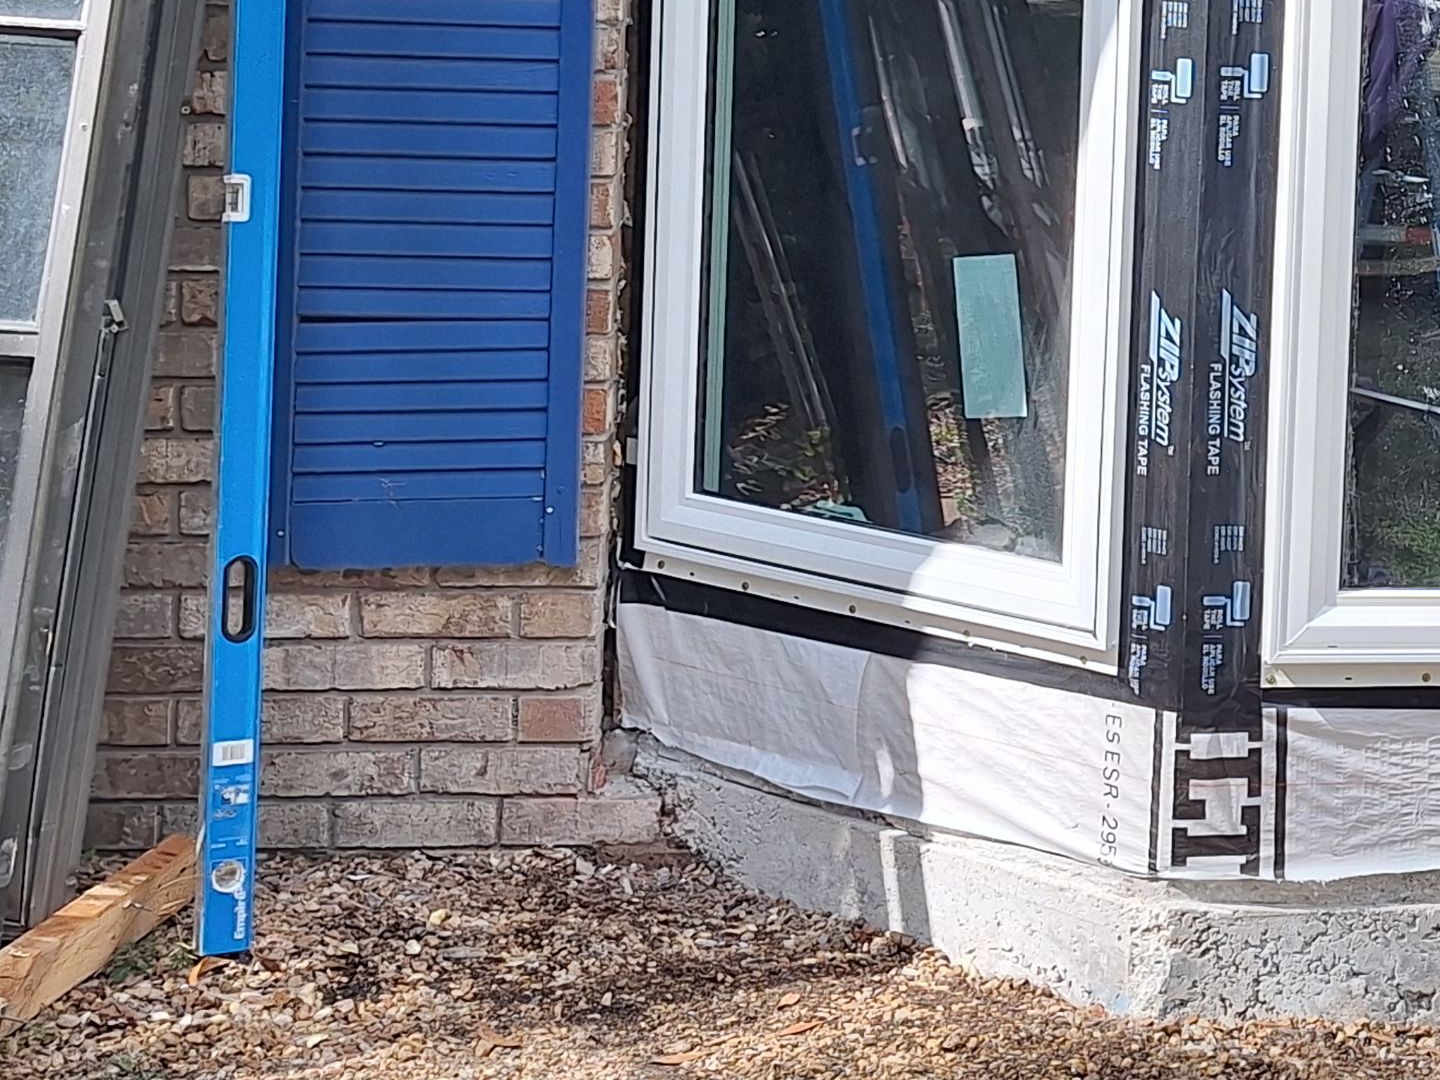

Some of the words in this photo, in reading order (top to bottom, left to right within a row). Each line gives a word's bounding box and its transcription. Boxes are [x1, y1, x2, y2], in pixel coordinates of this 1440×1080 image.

[1138, 364, 1151, 436] FLASHING
[1208, 363, 1222, 435] FLASHING
[1137, 439, 1149, 476] TAPE
[1207, 438, 1220, 476] TAPE
